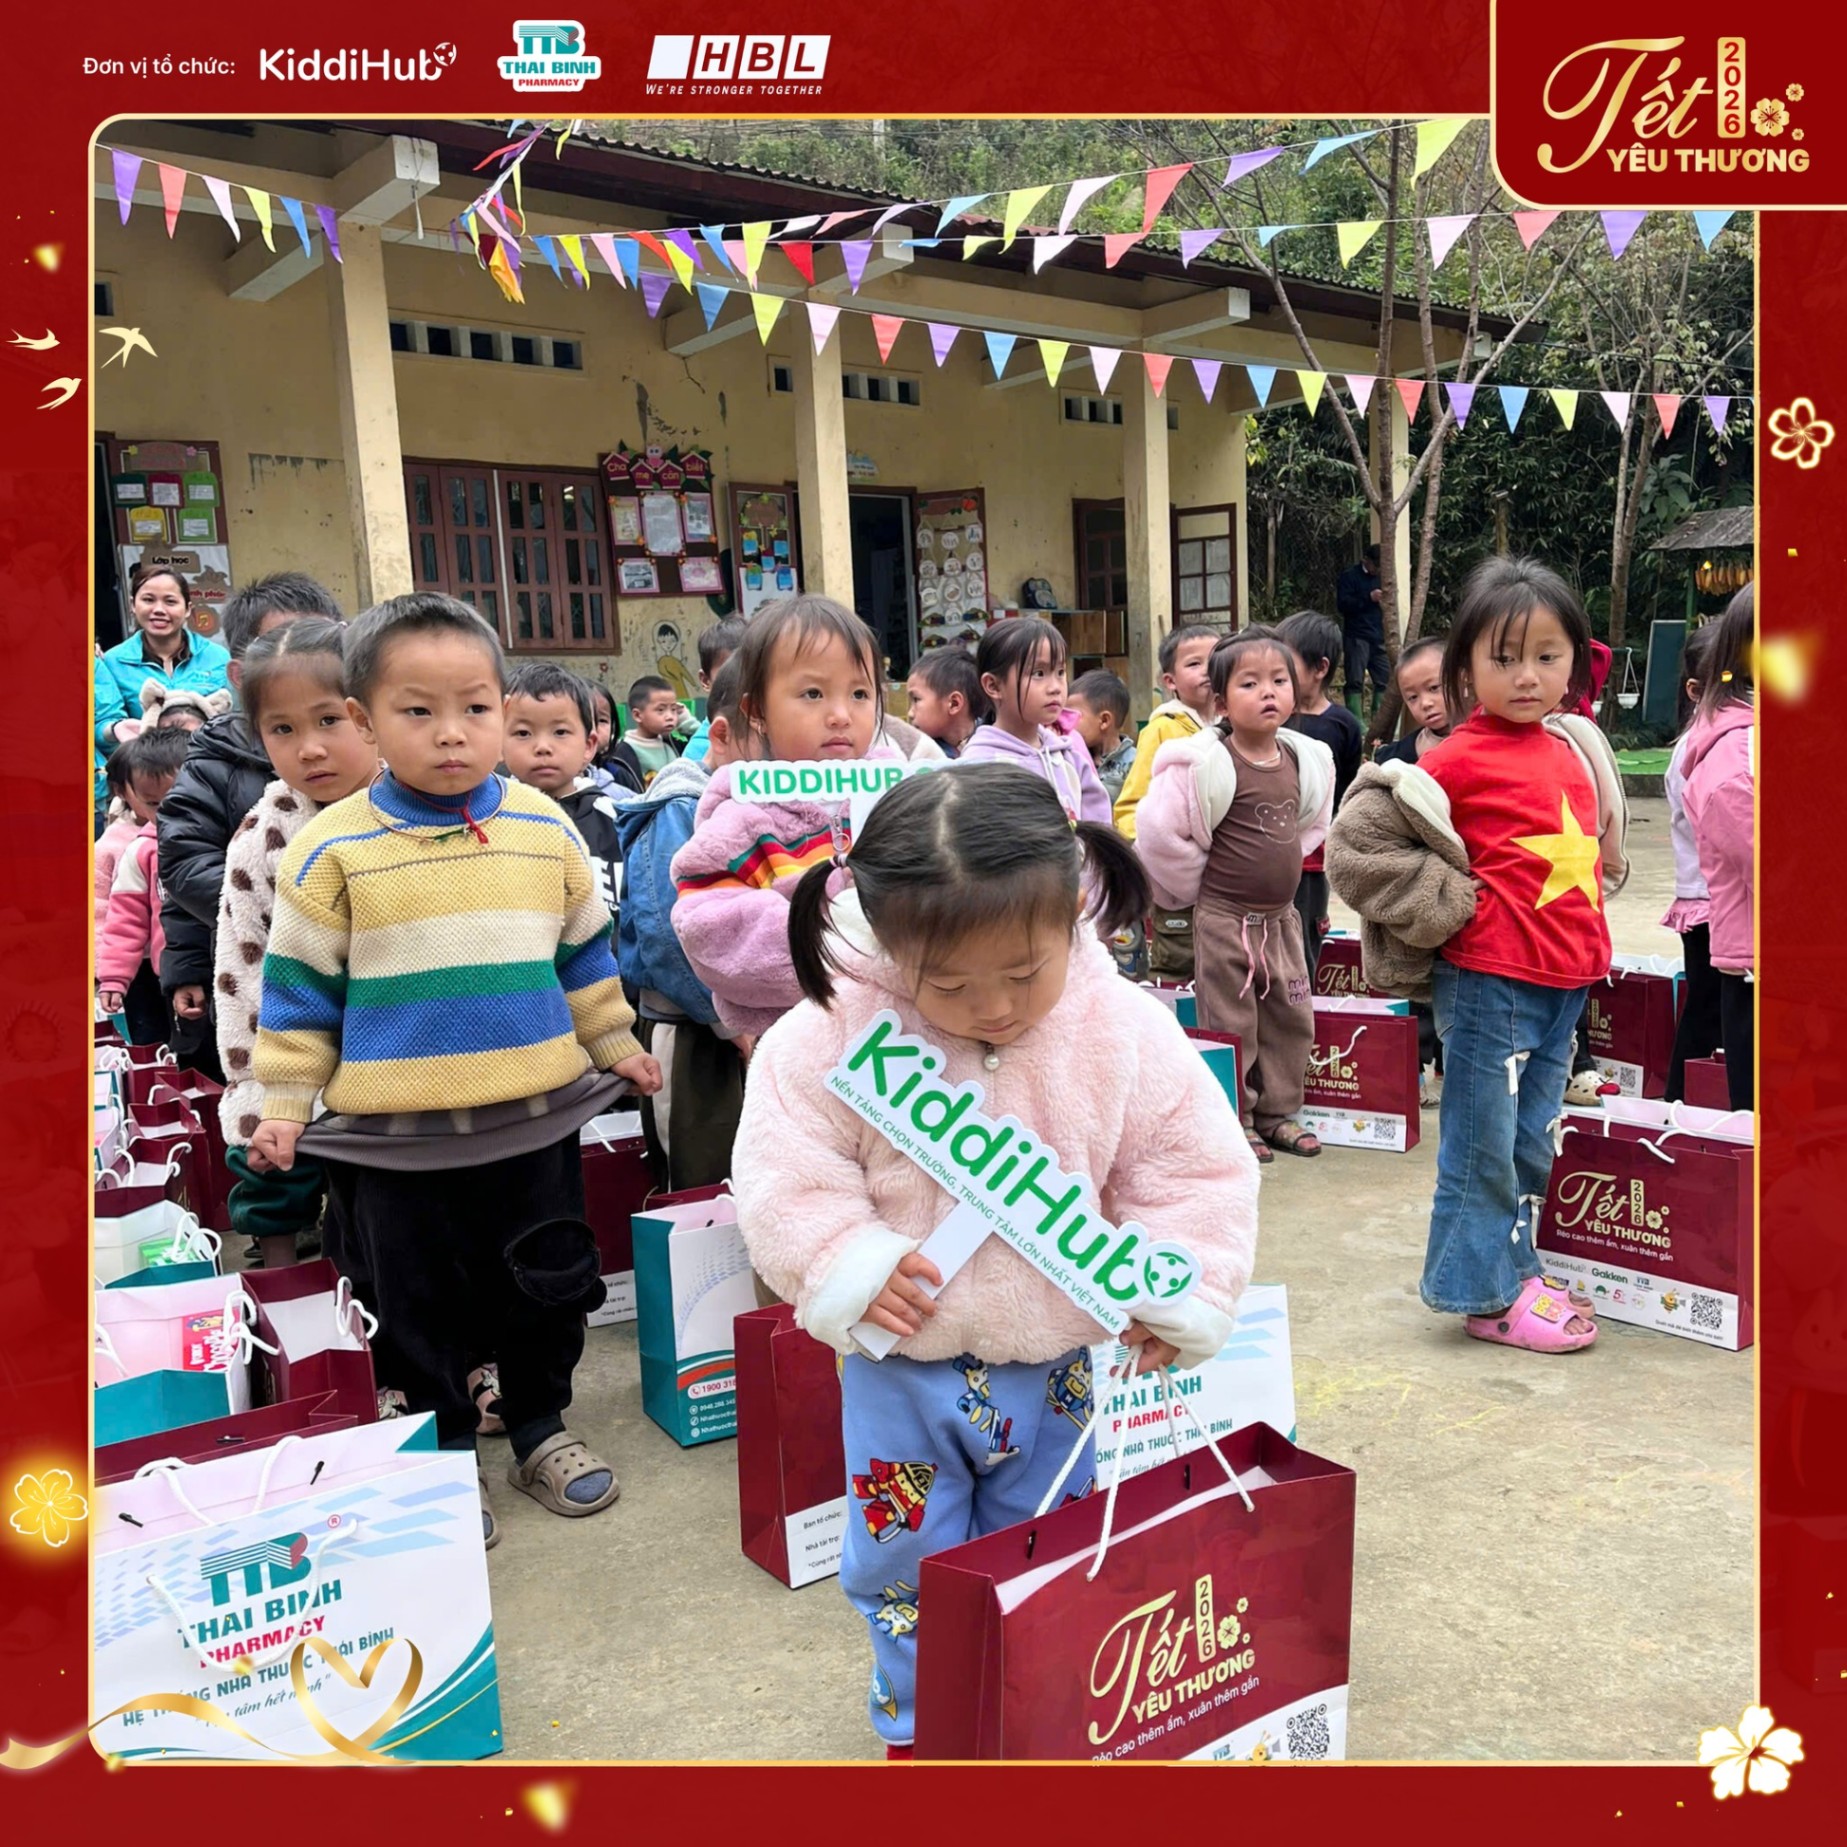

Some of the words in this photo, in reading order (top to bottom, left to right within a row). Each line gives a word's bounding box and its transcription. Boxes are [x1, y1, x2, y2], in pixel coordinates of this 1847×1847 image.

[606, 462, 627, 473] Cha
[171, 556, 189, 566] học
[847, 1020, 1140, 1302] KiddiHub
[830, 1075, 855, 1099] NỀN
[854, 1094, 884, 1124] TẢNG
[882, 1120, 915, 1149] CHỌN
[913, 1145, 957, 1190] TRƯỜNG,
[958, 1185, 995, 1220] TRUNG
[995, 1215, 1019, 1240] TÂM
[1017, 1236, 1041, 1260] LỚN
[1039, 1256, 1072, 1285] NHẤT
[1070, 1282, 1096, 1306] VIỆT
[1093, 1303, 1120, 1330] NAM
[1555, 1171, 1630, 1227] Tết
[1633, 1181, 1642, 1225] 2026
[1571, 1232, 1586, 1242] cao
[1584, 1218, 1611, 1235] YÊU
[1612, 1225, 1671, 1249] THƯƠNG
[1591, 1267, 1628, 1285] Gakken
[702, 1382, 722, 1393] 1900
[803, 1520, 816, 1530] Ban
[264, 1578, 343, 1623] BINH
[1198, 1579, 1213, 1658] 2026
[122, 1709, 145, 1728] HỆ
[257, 1653, 313, 1686] THUC
[358, 1626, 395, 1651] BÌNH
[1088, 1589, 1195, 1746] Tết
[1131, 1686, 1172, 1725] YÊU
[1174, 1648, 1256, 1704] THƯƠNG
[234, 1702, 261, 1718] tâm
[264, 1689, 287, 1708] hết
[1114, 1739, 1136, 1758] cao
[1137, 1722, 1165, 1747] thêm
[1166, 1713, 1186, 1732] ấm,
[1187, 1698, 1213, 1722] xuân
[1213, 1686, 1240, 1708] thêm
[1240, 1674, 1260, 1697] gần
